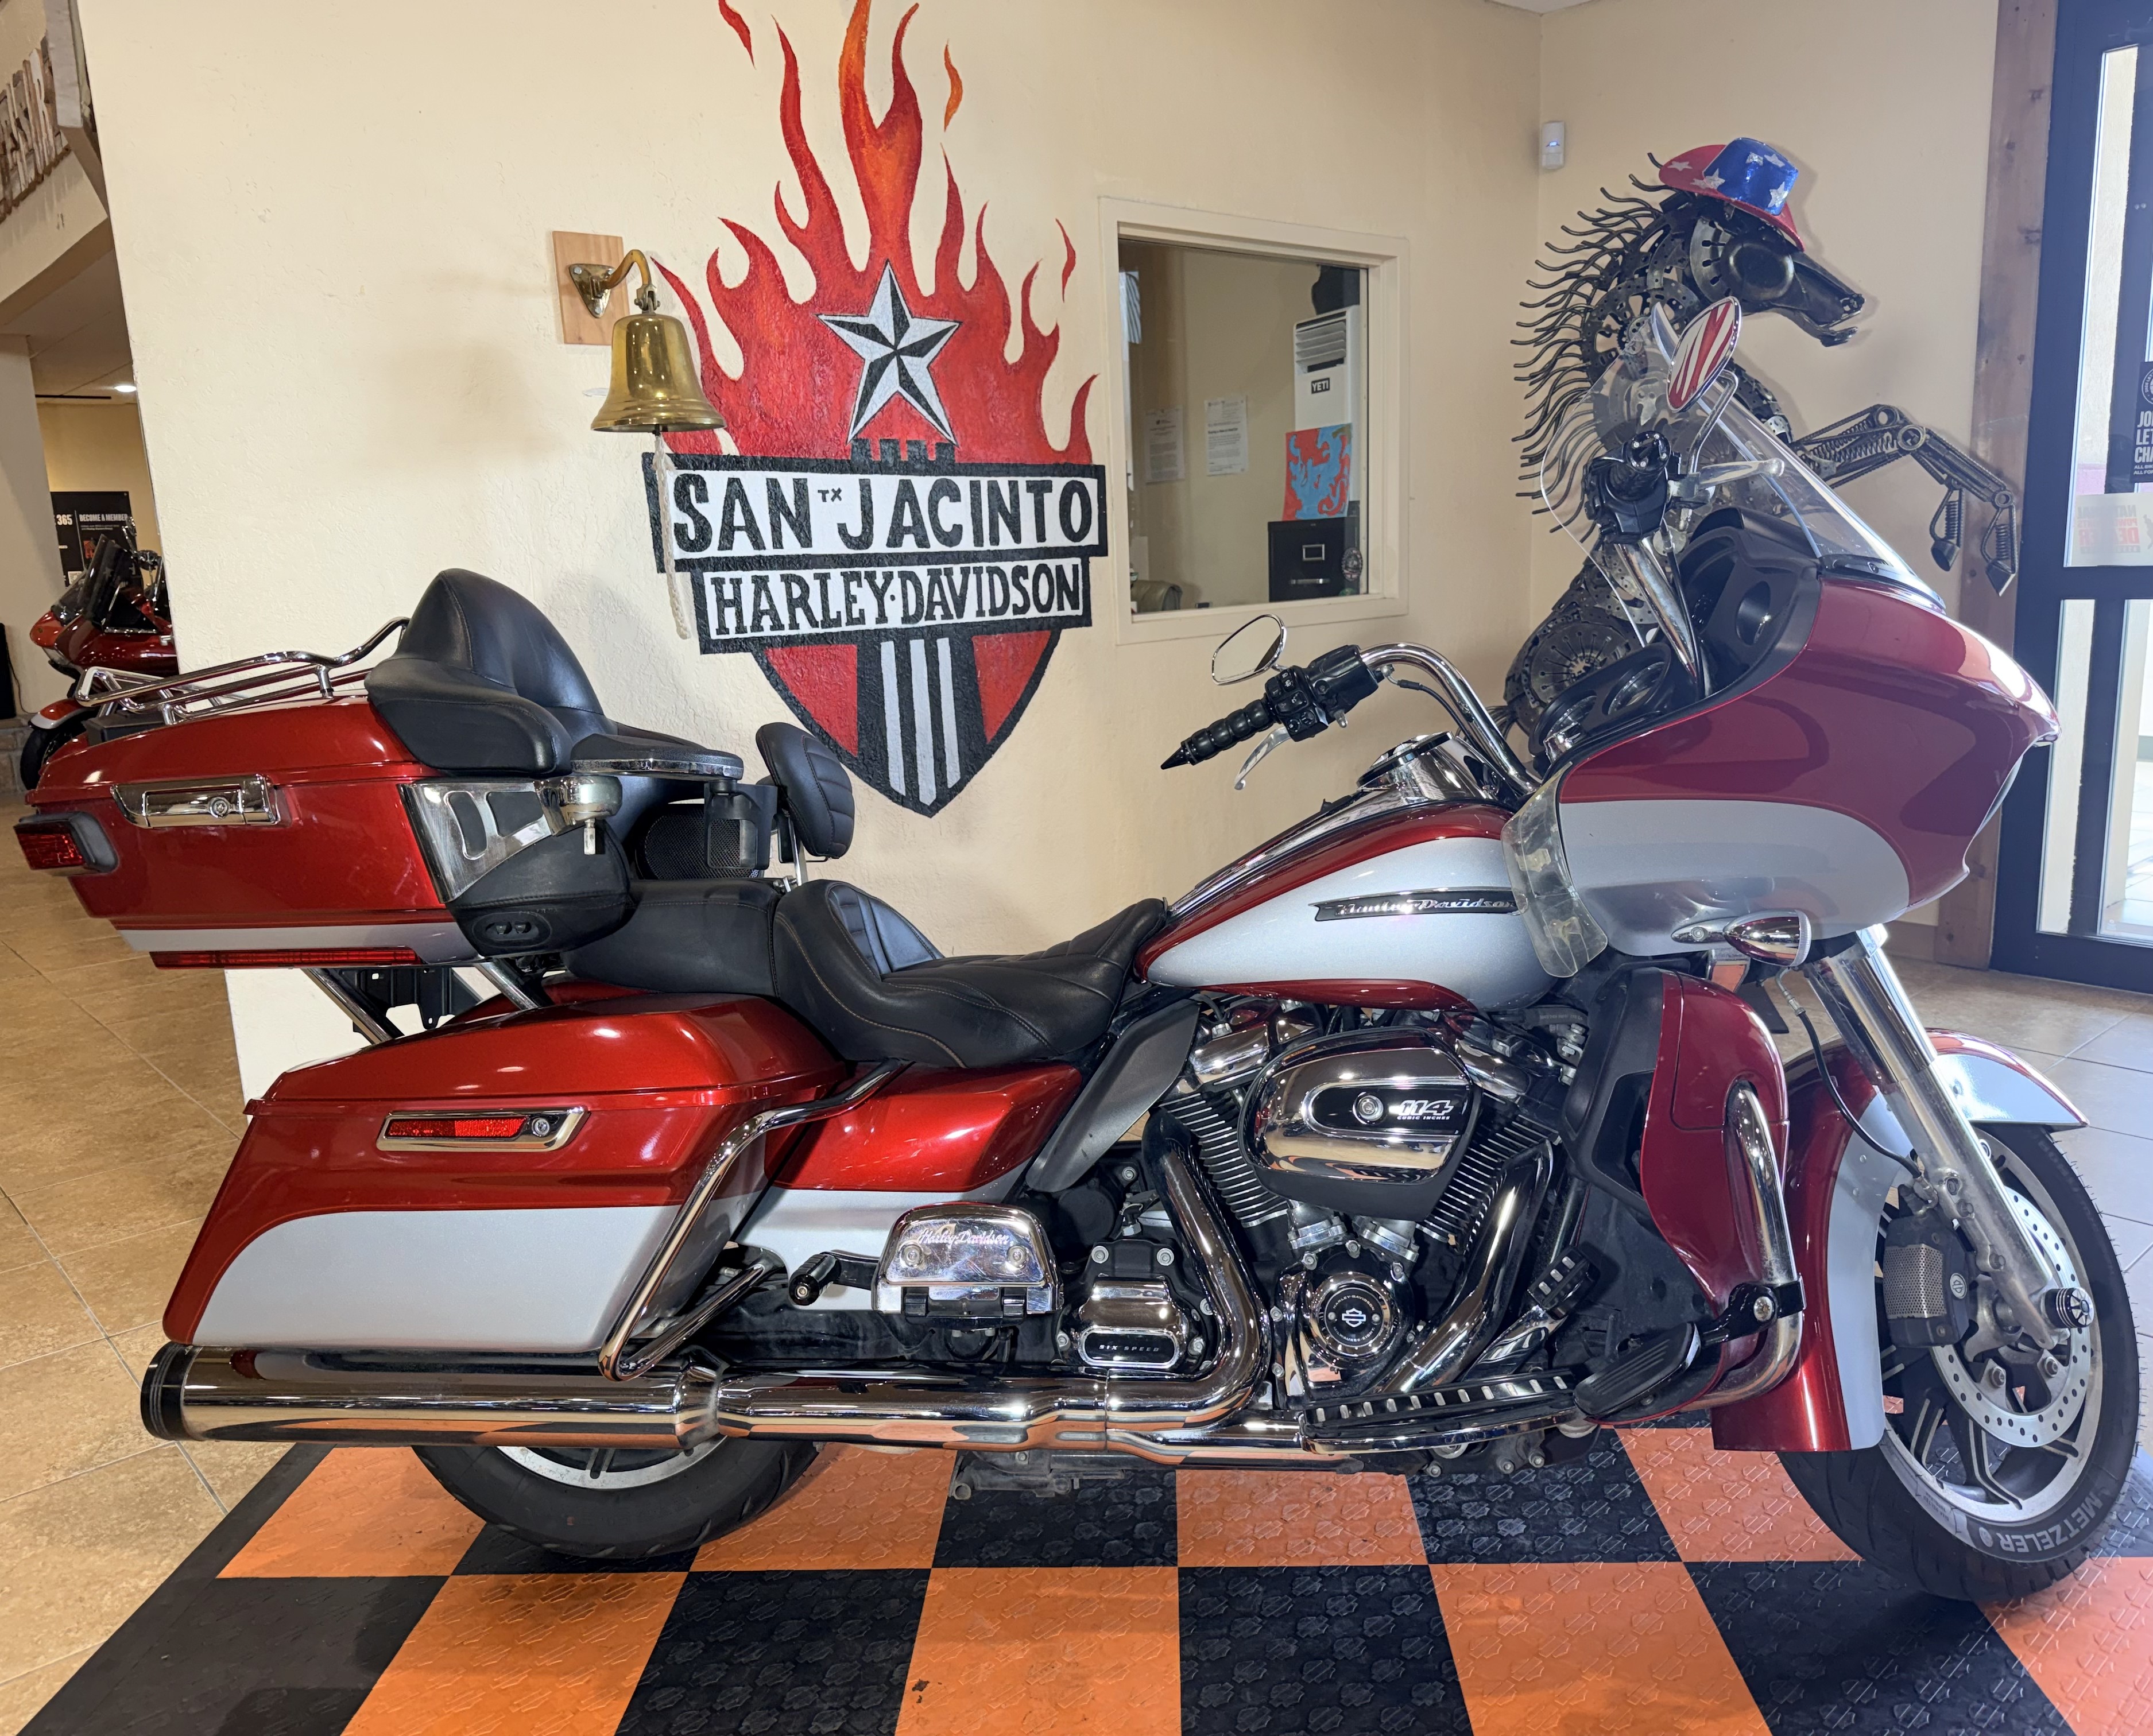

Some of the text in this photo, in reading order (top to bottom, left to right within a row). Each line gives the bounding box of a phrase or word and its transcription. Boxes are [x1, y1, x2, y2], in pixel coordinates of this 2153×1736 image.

[1312, 380, 1329, 392] YETI
[56, 514, 72, 525] 365
[106, 514, 127, 522] MEMBER
[673, 474, 1092, 552] SAN TX JACINTO
[1398, 1100, 1454, 1115] 114
[1996, 1491, 2104, 1553] METZELER
